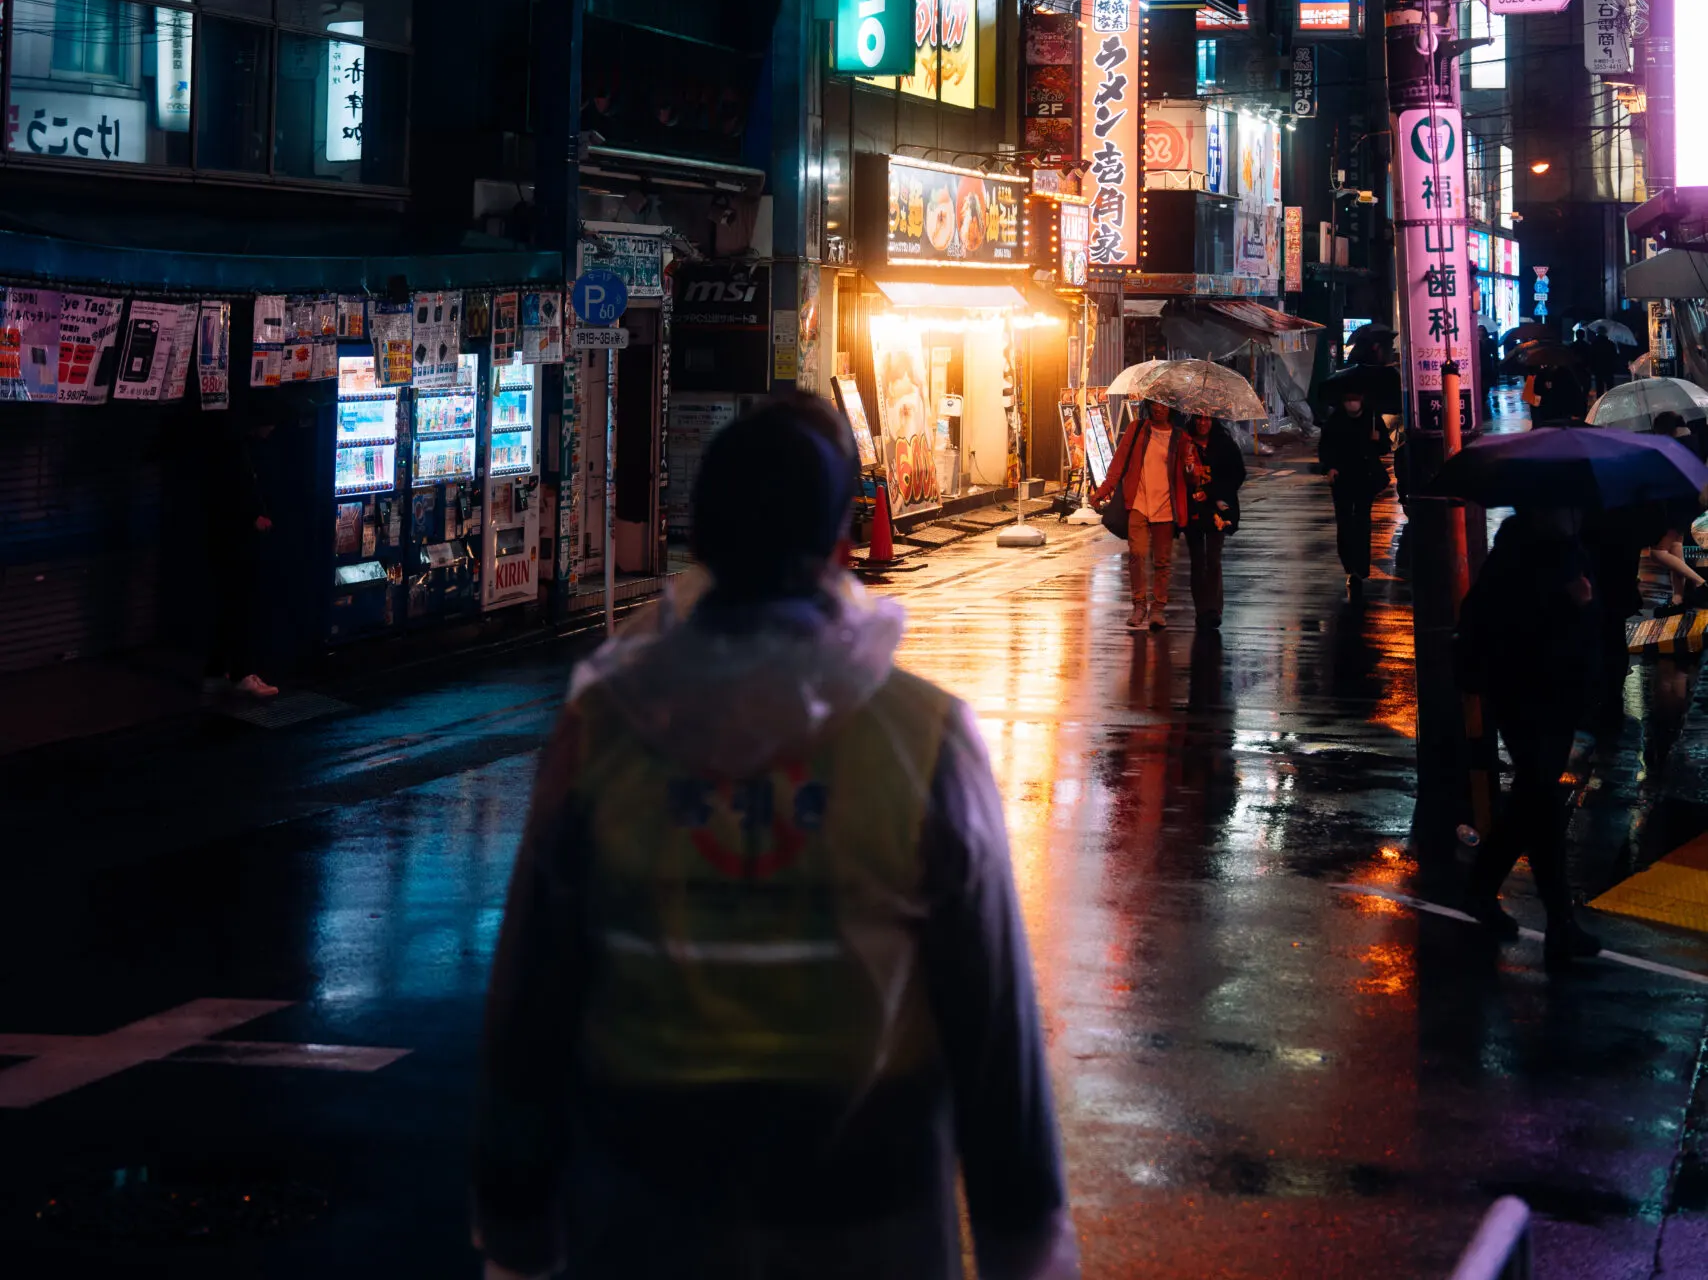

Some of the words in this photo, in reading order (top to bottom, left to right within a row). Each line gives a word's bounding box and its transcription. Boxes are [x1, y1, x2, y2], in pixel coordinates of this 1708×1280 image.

[1038, 102, 1064, 115] 2F
[1297, 102, 1308, 111] 2F
[1421, 174, 1460, 343] 福山歯科
[684, 280, 760, 303] msi
[84, 298, 106, 317] Tag
[584, 284, 606, 321] P
[599, 303, 615, 320] 60
[1430, 399, 1465, 411] 外田
[495, 560, 530, 590] KIRIN
